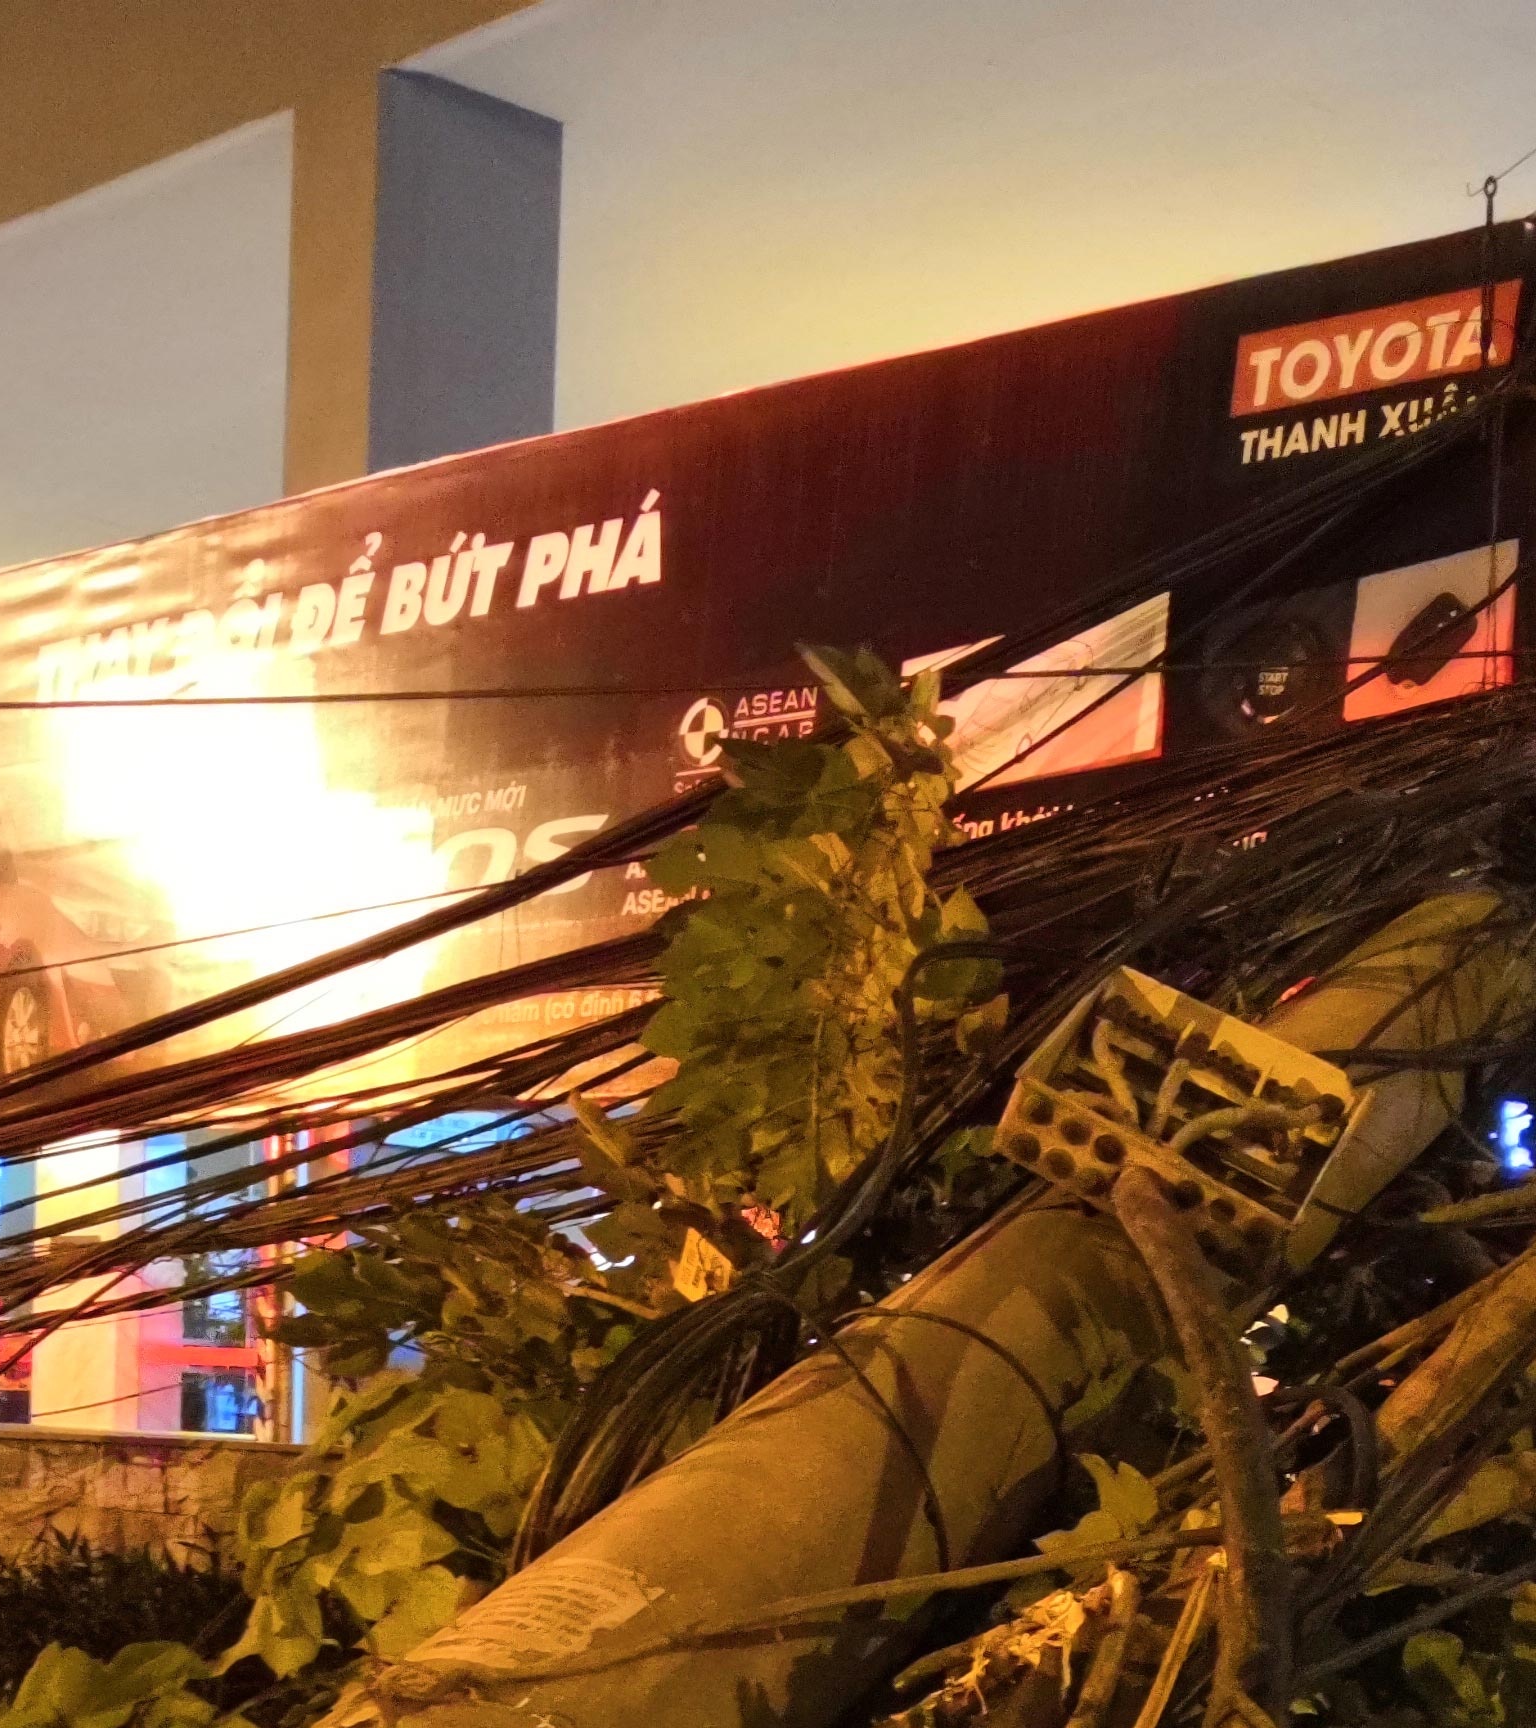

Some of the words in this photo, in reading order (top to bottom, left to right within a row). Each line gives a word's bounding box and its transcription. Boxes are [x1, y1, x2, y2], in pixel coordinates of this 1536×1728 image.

[1249, 304, 1497, 407] TOYOTA
[1240, 409, 1367, 465] THANH
[516, 488, 662, 609] PHÁ
[734, 687, 818, 718] ASEAN
